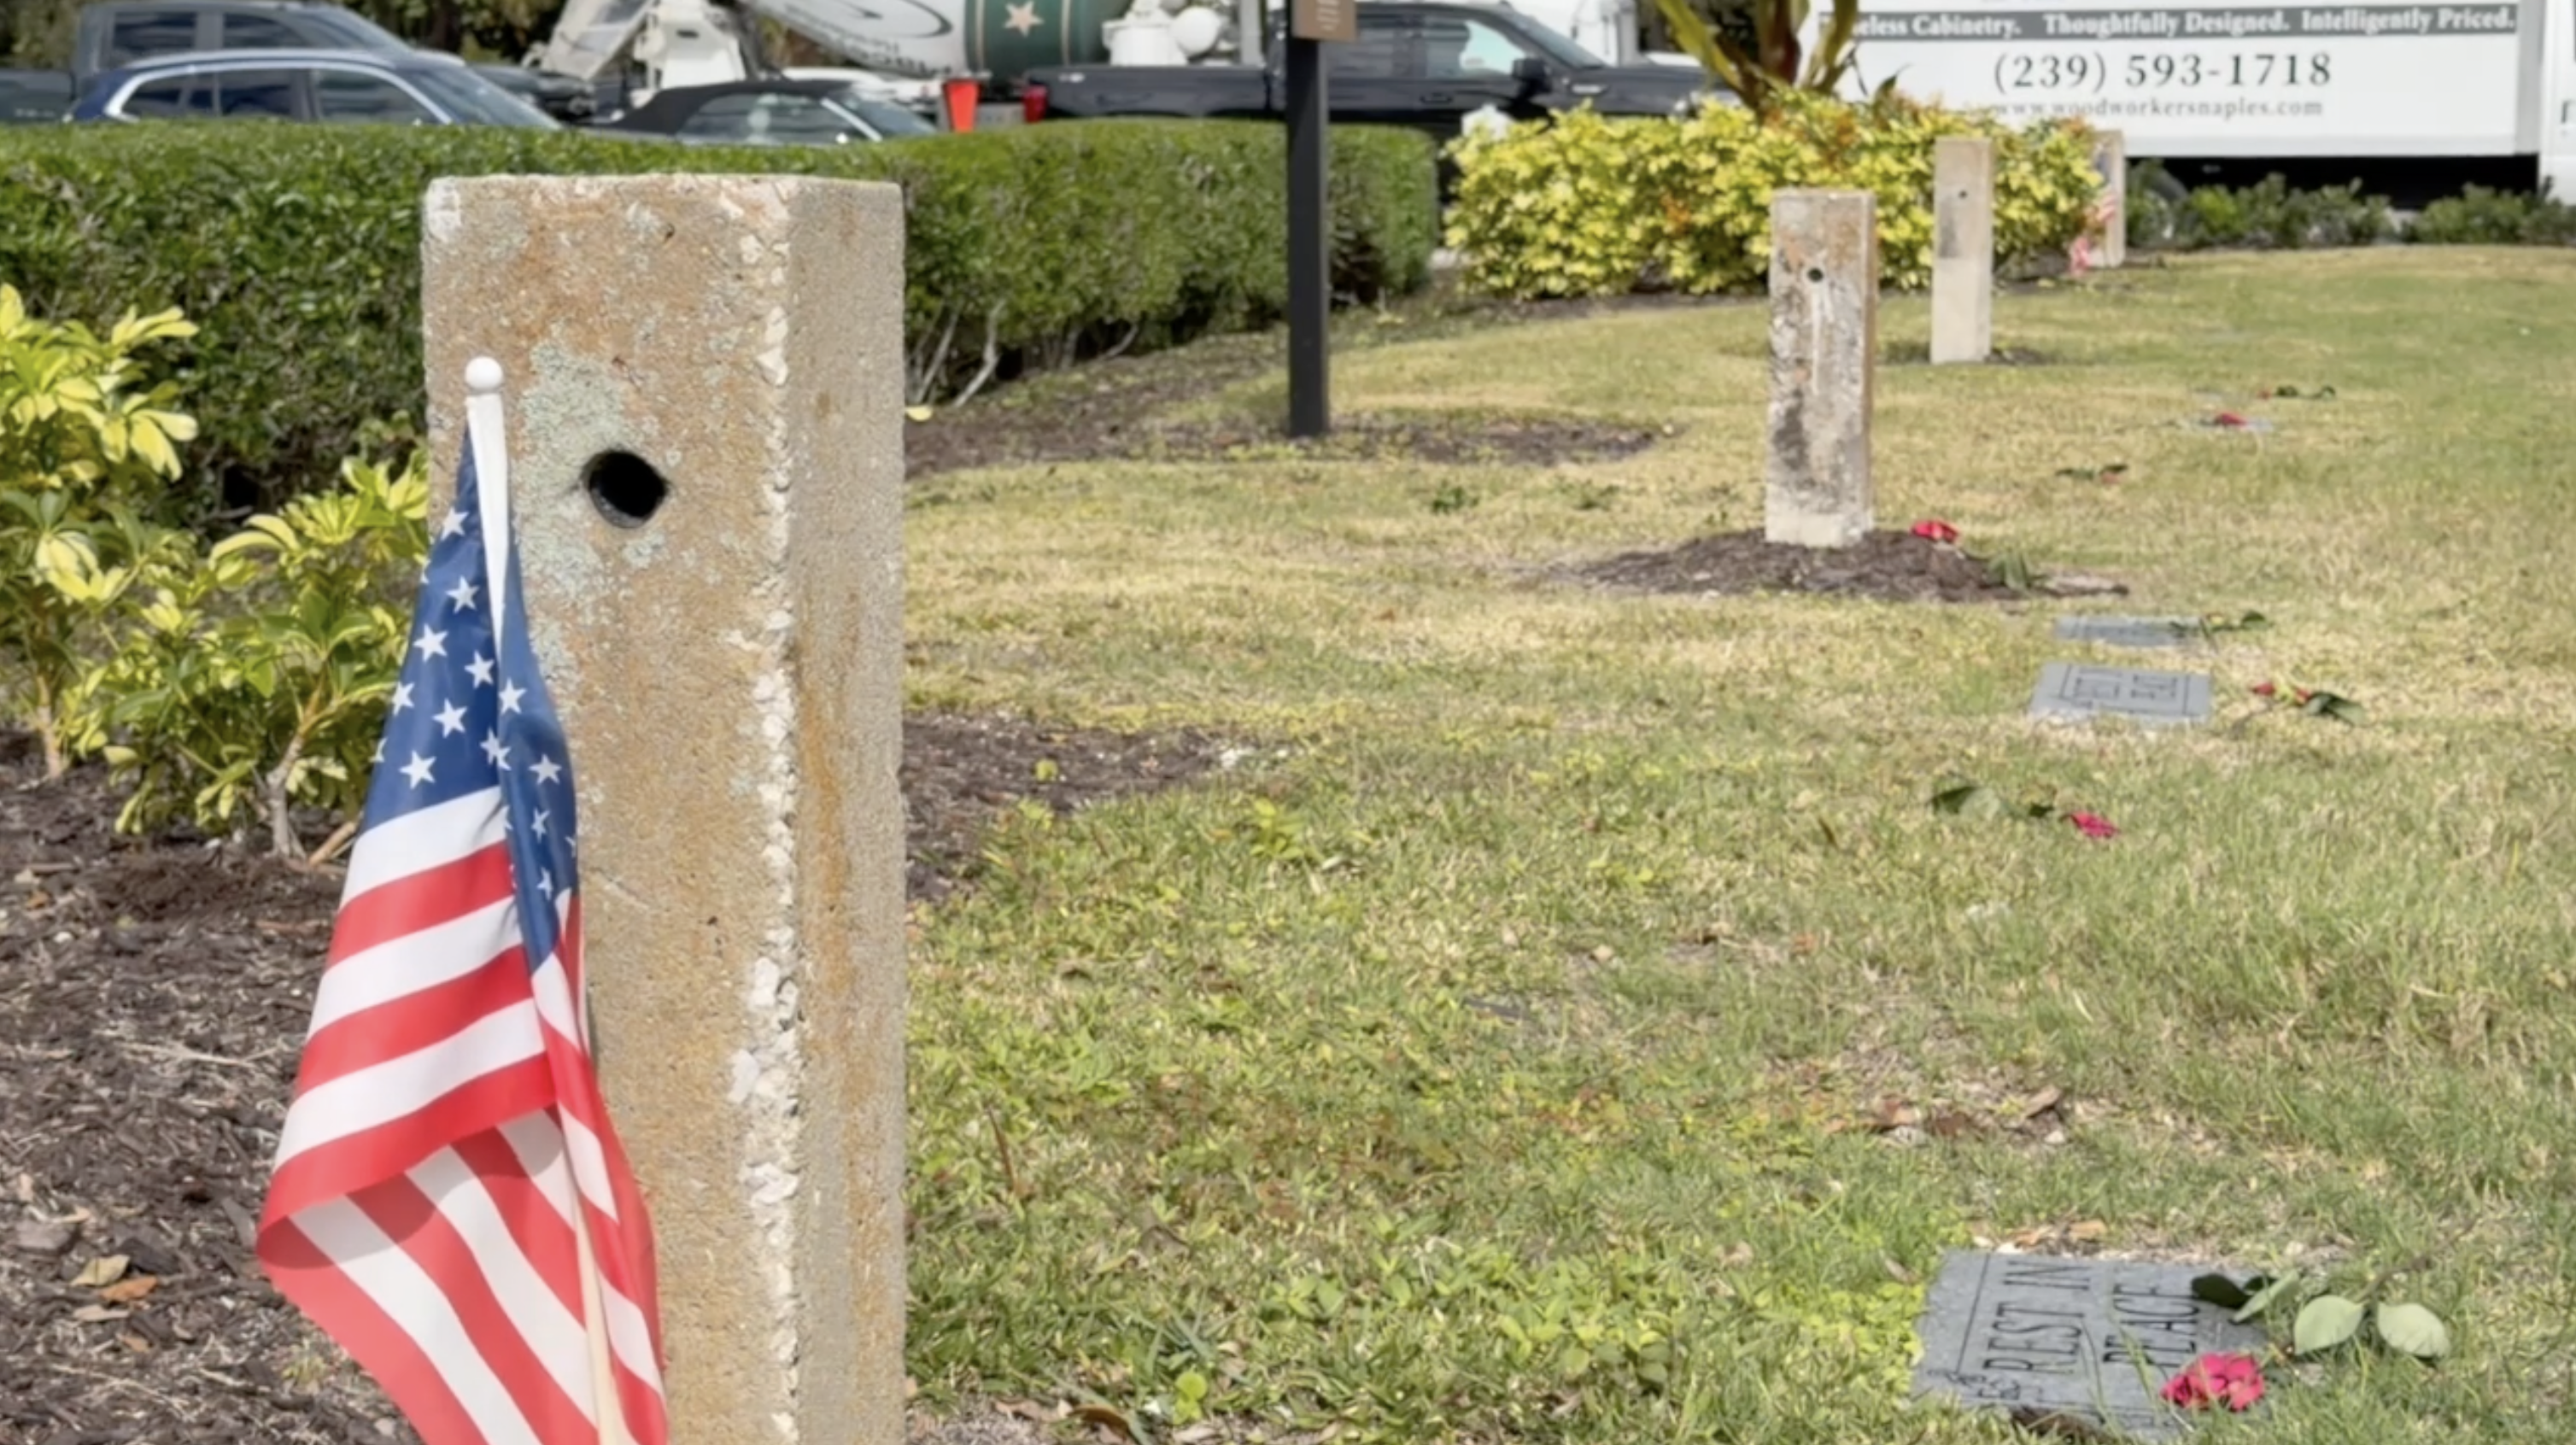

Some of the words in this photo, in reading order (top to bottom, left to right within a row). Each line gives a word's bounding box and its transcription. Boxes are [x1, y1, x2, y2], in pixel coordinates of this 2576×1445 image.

[1912, 15, 2022, 39] Cabinetry.
[2042, 12, 2178, 39] Thoughtfully
[2185, 10, 2290, 37] Designed.
[2301, 8, 2432, 34] Intelligently
[2437, 7, 2515, 30] Priced.
[1994, 52, 2105, 95] (239)
[2125, 52, 2331, 88] 593-1718
